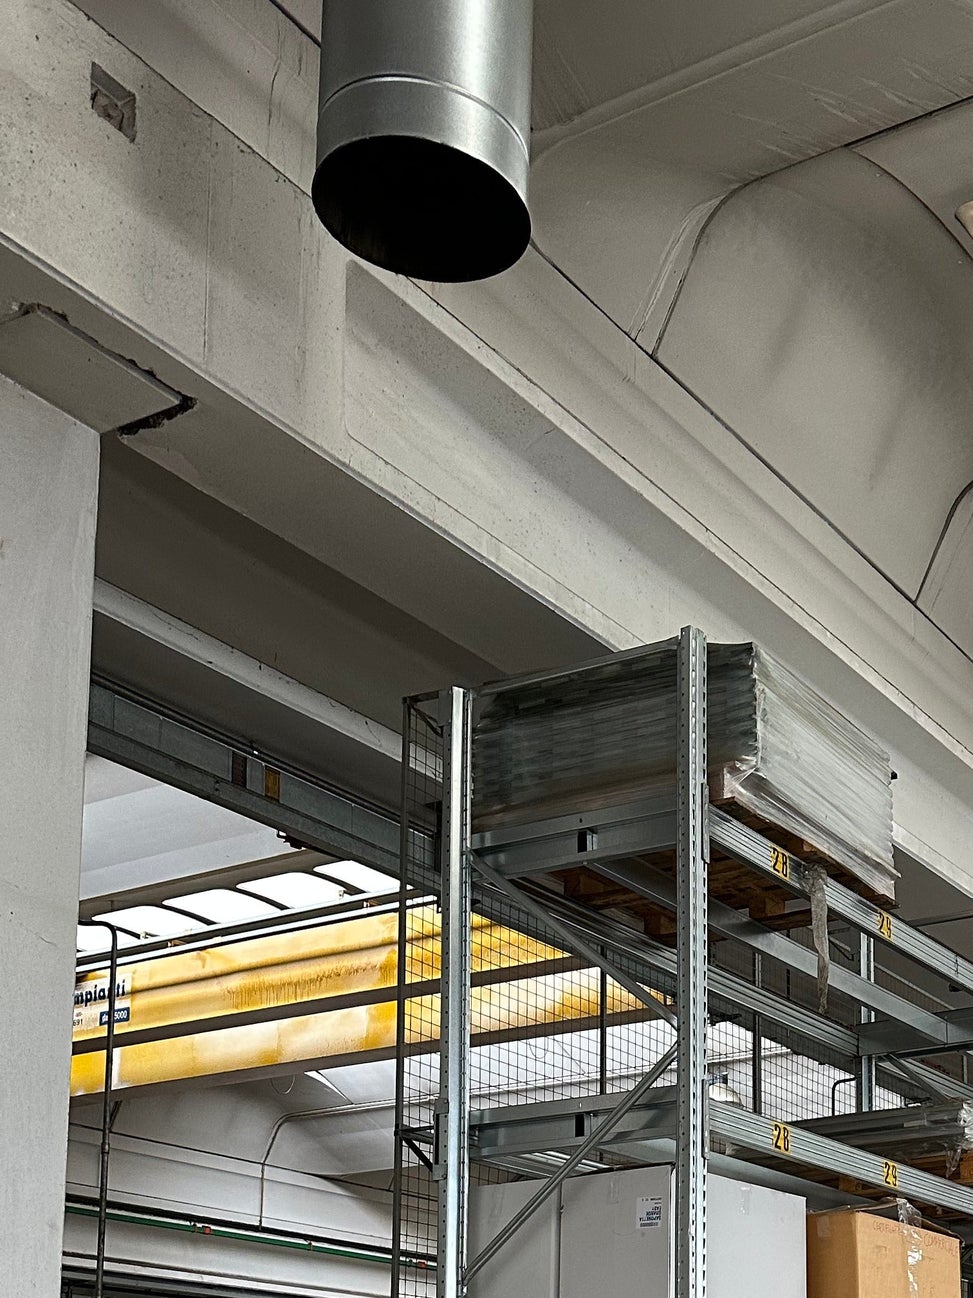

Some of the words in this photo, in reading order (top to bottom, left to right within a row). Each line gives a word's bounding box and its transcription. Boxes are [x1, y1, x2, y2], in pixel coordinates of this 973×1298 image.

[771, 847, 789, 878] 28
[876, 911, 892, 938] 29
[773, 1122, 790, 1152] 28
[883, 1160, 898, 1187] 29
